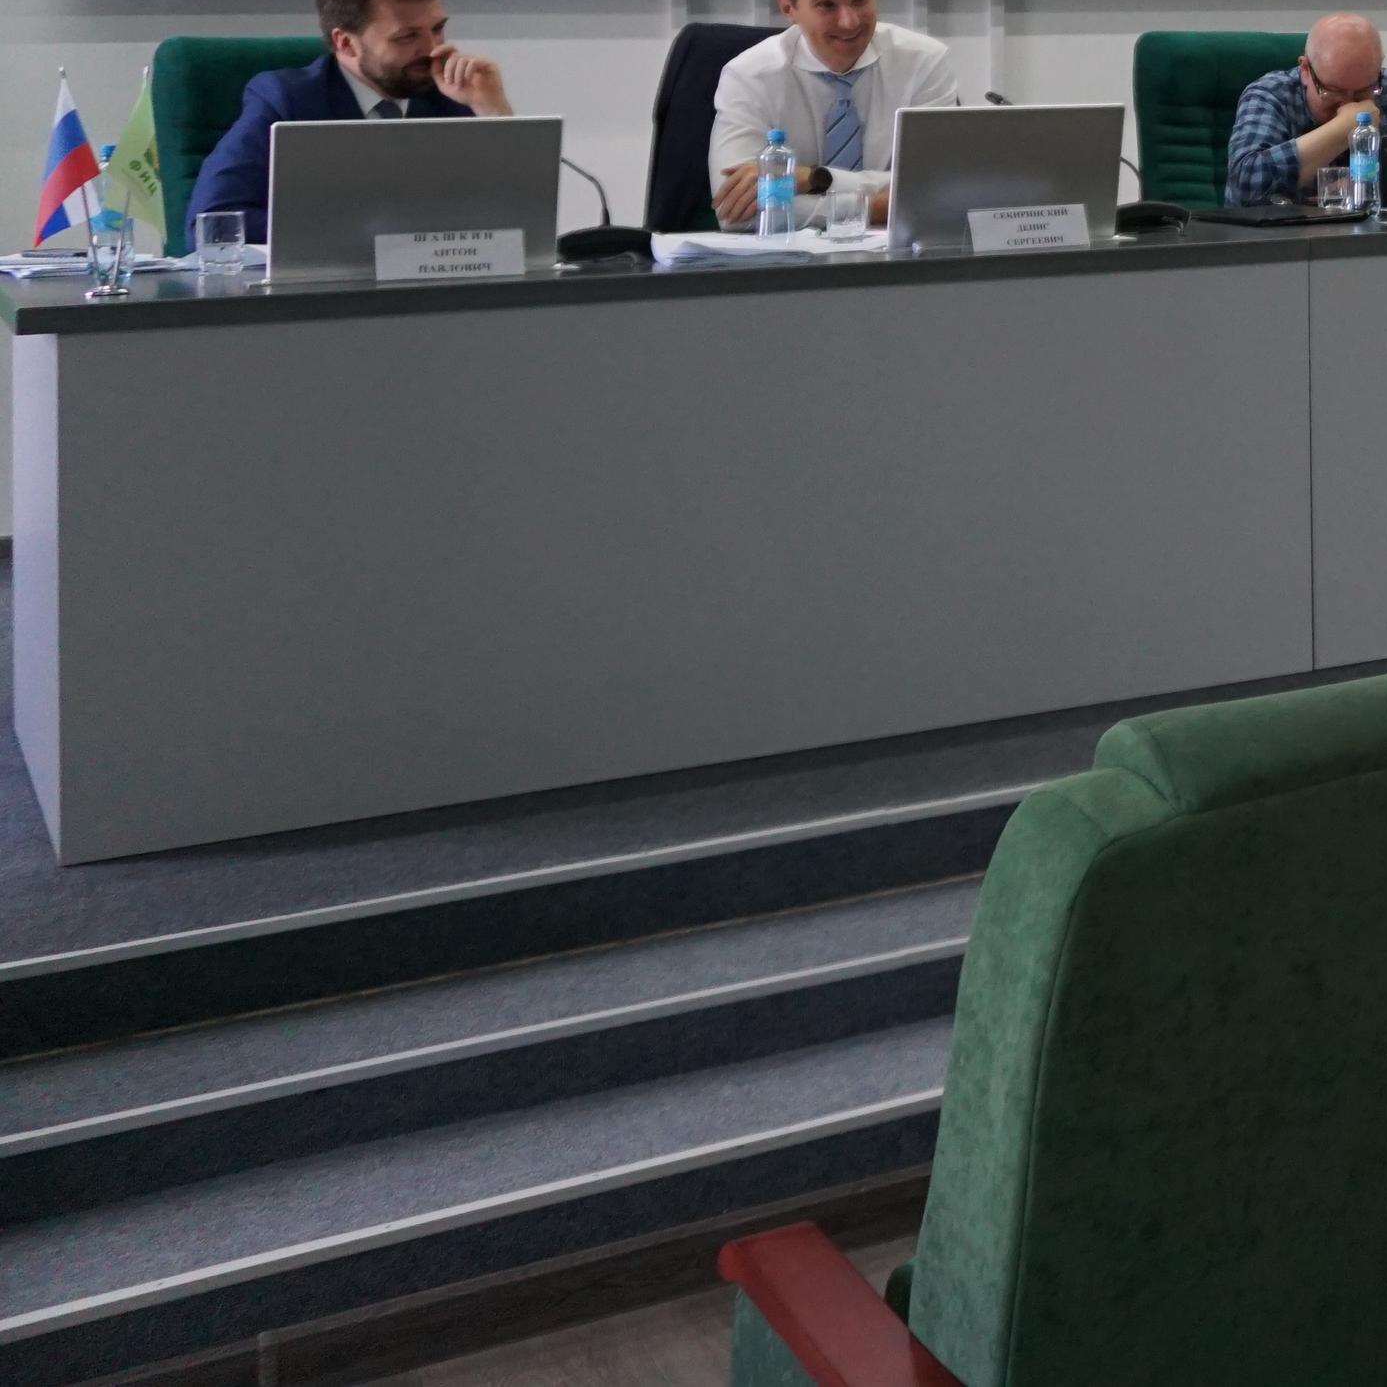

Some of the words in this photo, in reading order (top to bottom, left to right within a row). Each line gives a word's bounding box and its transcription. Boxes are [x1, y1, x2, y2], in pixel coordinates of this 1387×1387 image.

[1006, 235, 1064, 246] СЕРГЕЕВИЧ
[432, 248, 477, 257] АНТОН
[418, 262, 492, 273] ПАВЛОВИЧ
